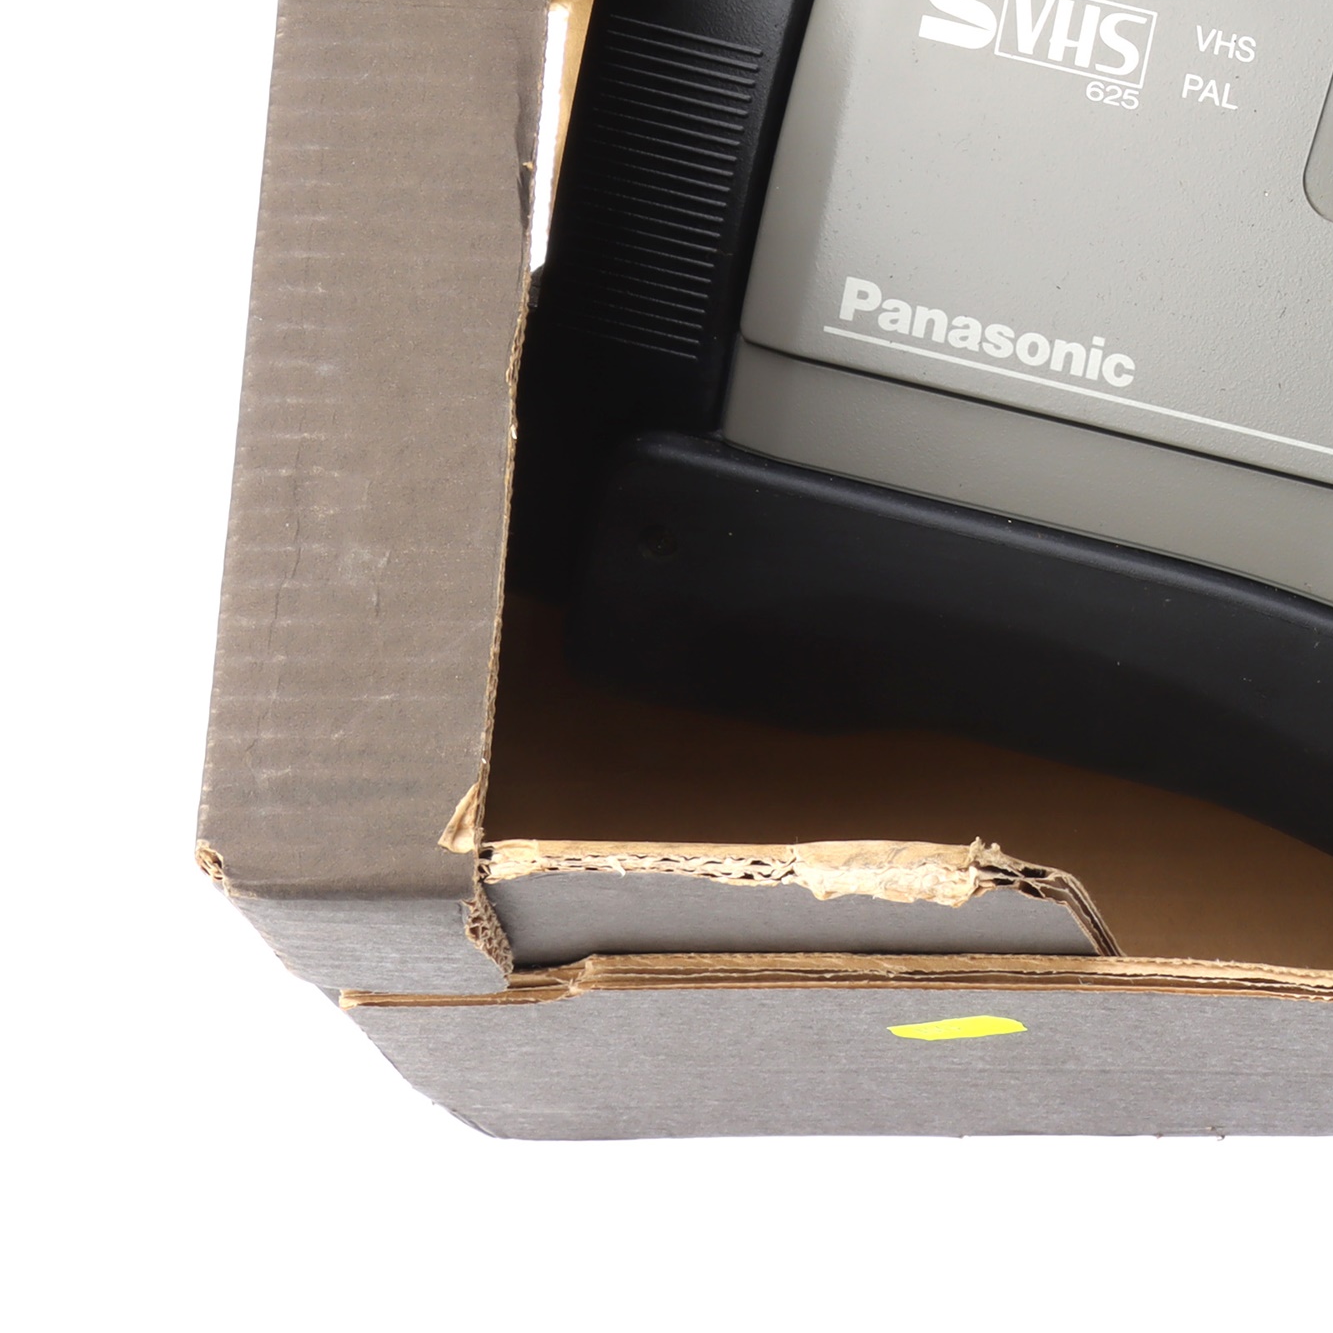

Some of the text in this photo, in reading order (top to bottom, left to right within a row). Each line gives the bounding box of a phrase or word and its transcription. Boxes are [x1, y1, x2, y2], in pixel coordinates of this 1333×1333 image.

[1195, 25, 1257, 63] VHS
[1085, 80, 1140, 111] 625
[1181, 73, 1239, 110] PAL
[838, 276, 1136, 388] Panasonic
